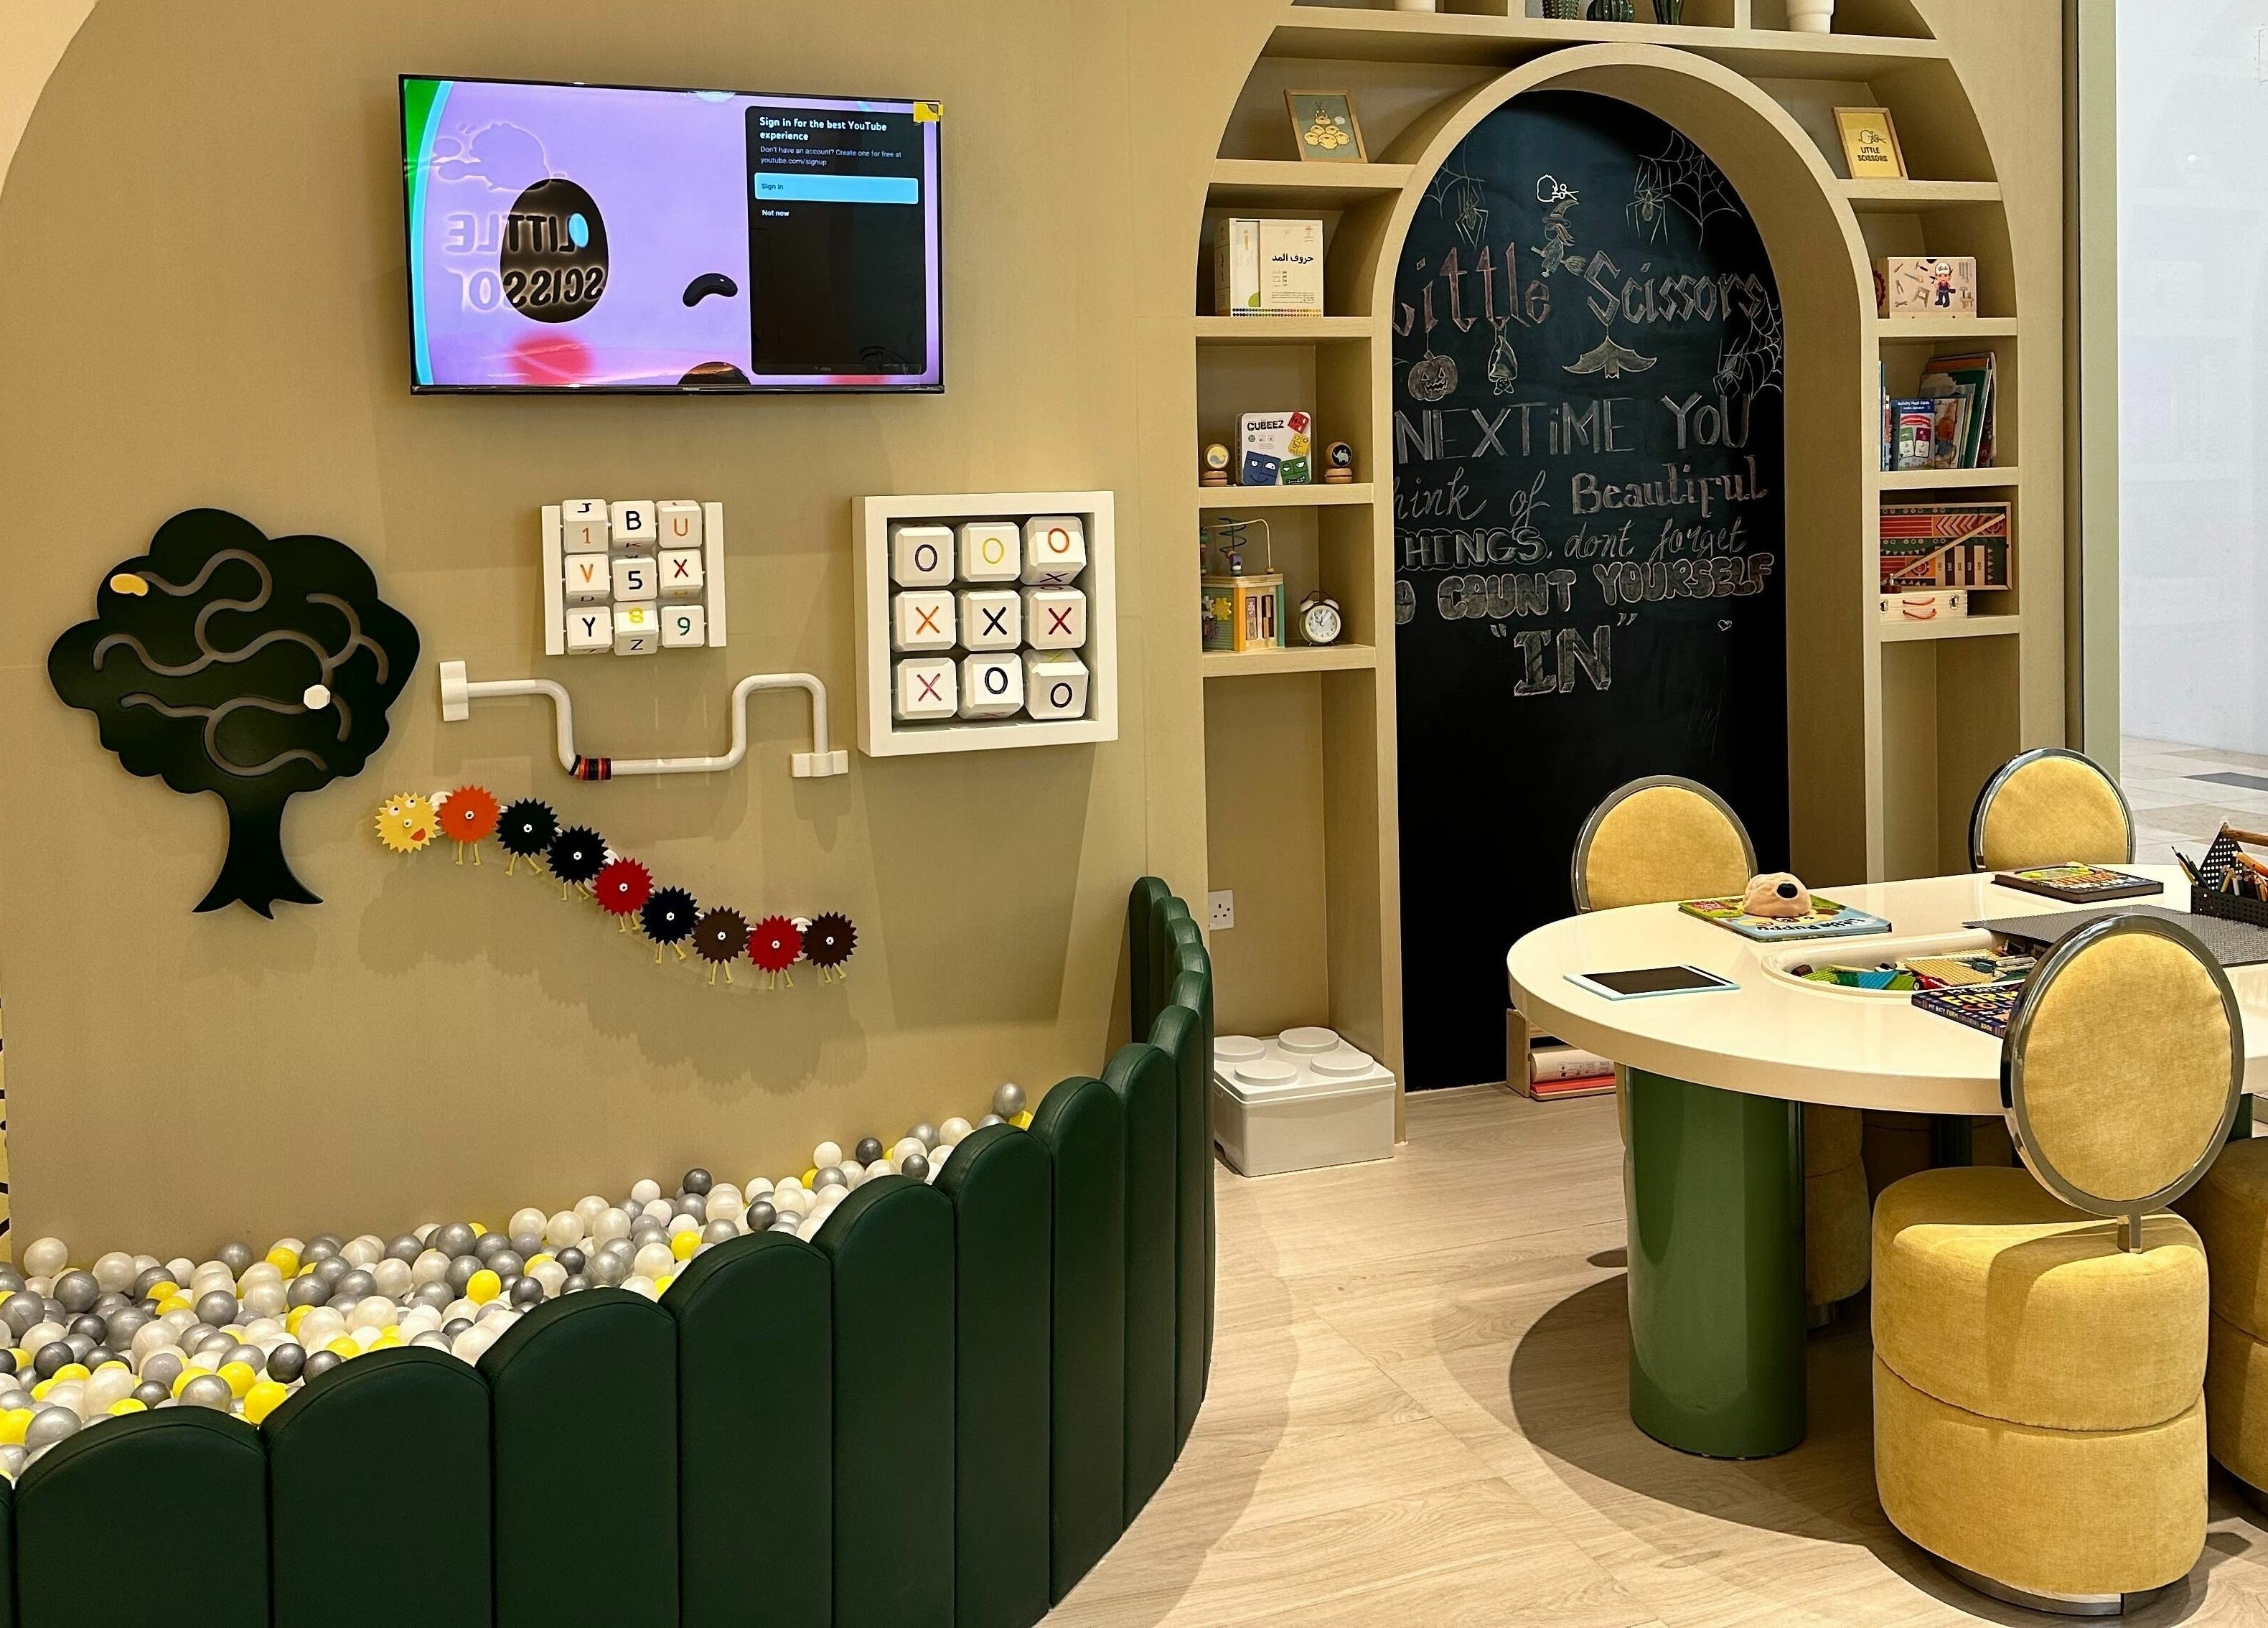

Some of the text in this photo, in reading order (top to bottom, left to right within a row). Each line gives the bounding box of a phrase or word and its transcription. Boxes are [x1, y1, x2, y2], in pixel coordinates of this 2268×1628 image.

[759, 116, 887, 131] Sign in for the best YouTube
[759, 131, 809, 141] experience
[760, 157, 828, 167] youtube.com/signup
[761, 183, 777, 192] Sign
[1272, 253, 1314, 265] حروف المد
[1583, 250, 1767, 328] Scissors
[1247, 419, 1284, 431] CUBEEZ
[1660, 392, 1751, 450] YOU
[1393, 466, 1488, 520] hink
[1509, 469, 1551, 531] of
[625, 510, 642, 530] B
[673, 518, 689, 537] U
[1650, 517, 1748, 561] forget
[580, 558, 689, 590] V 5 X
[1438, 569, 1577, 620] COUNT
[1593, 552, 1776, 607] YOURSELF
[581, 607, 691, 637] Y 8 9
[915, 605, 1072, 636] X X X
[917, 673, 942, 702] X
